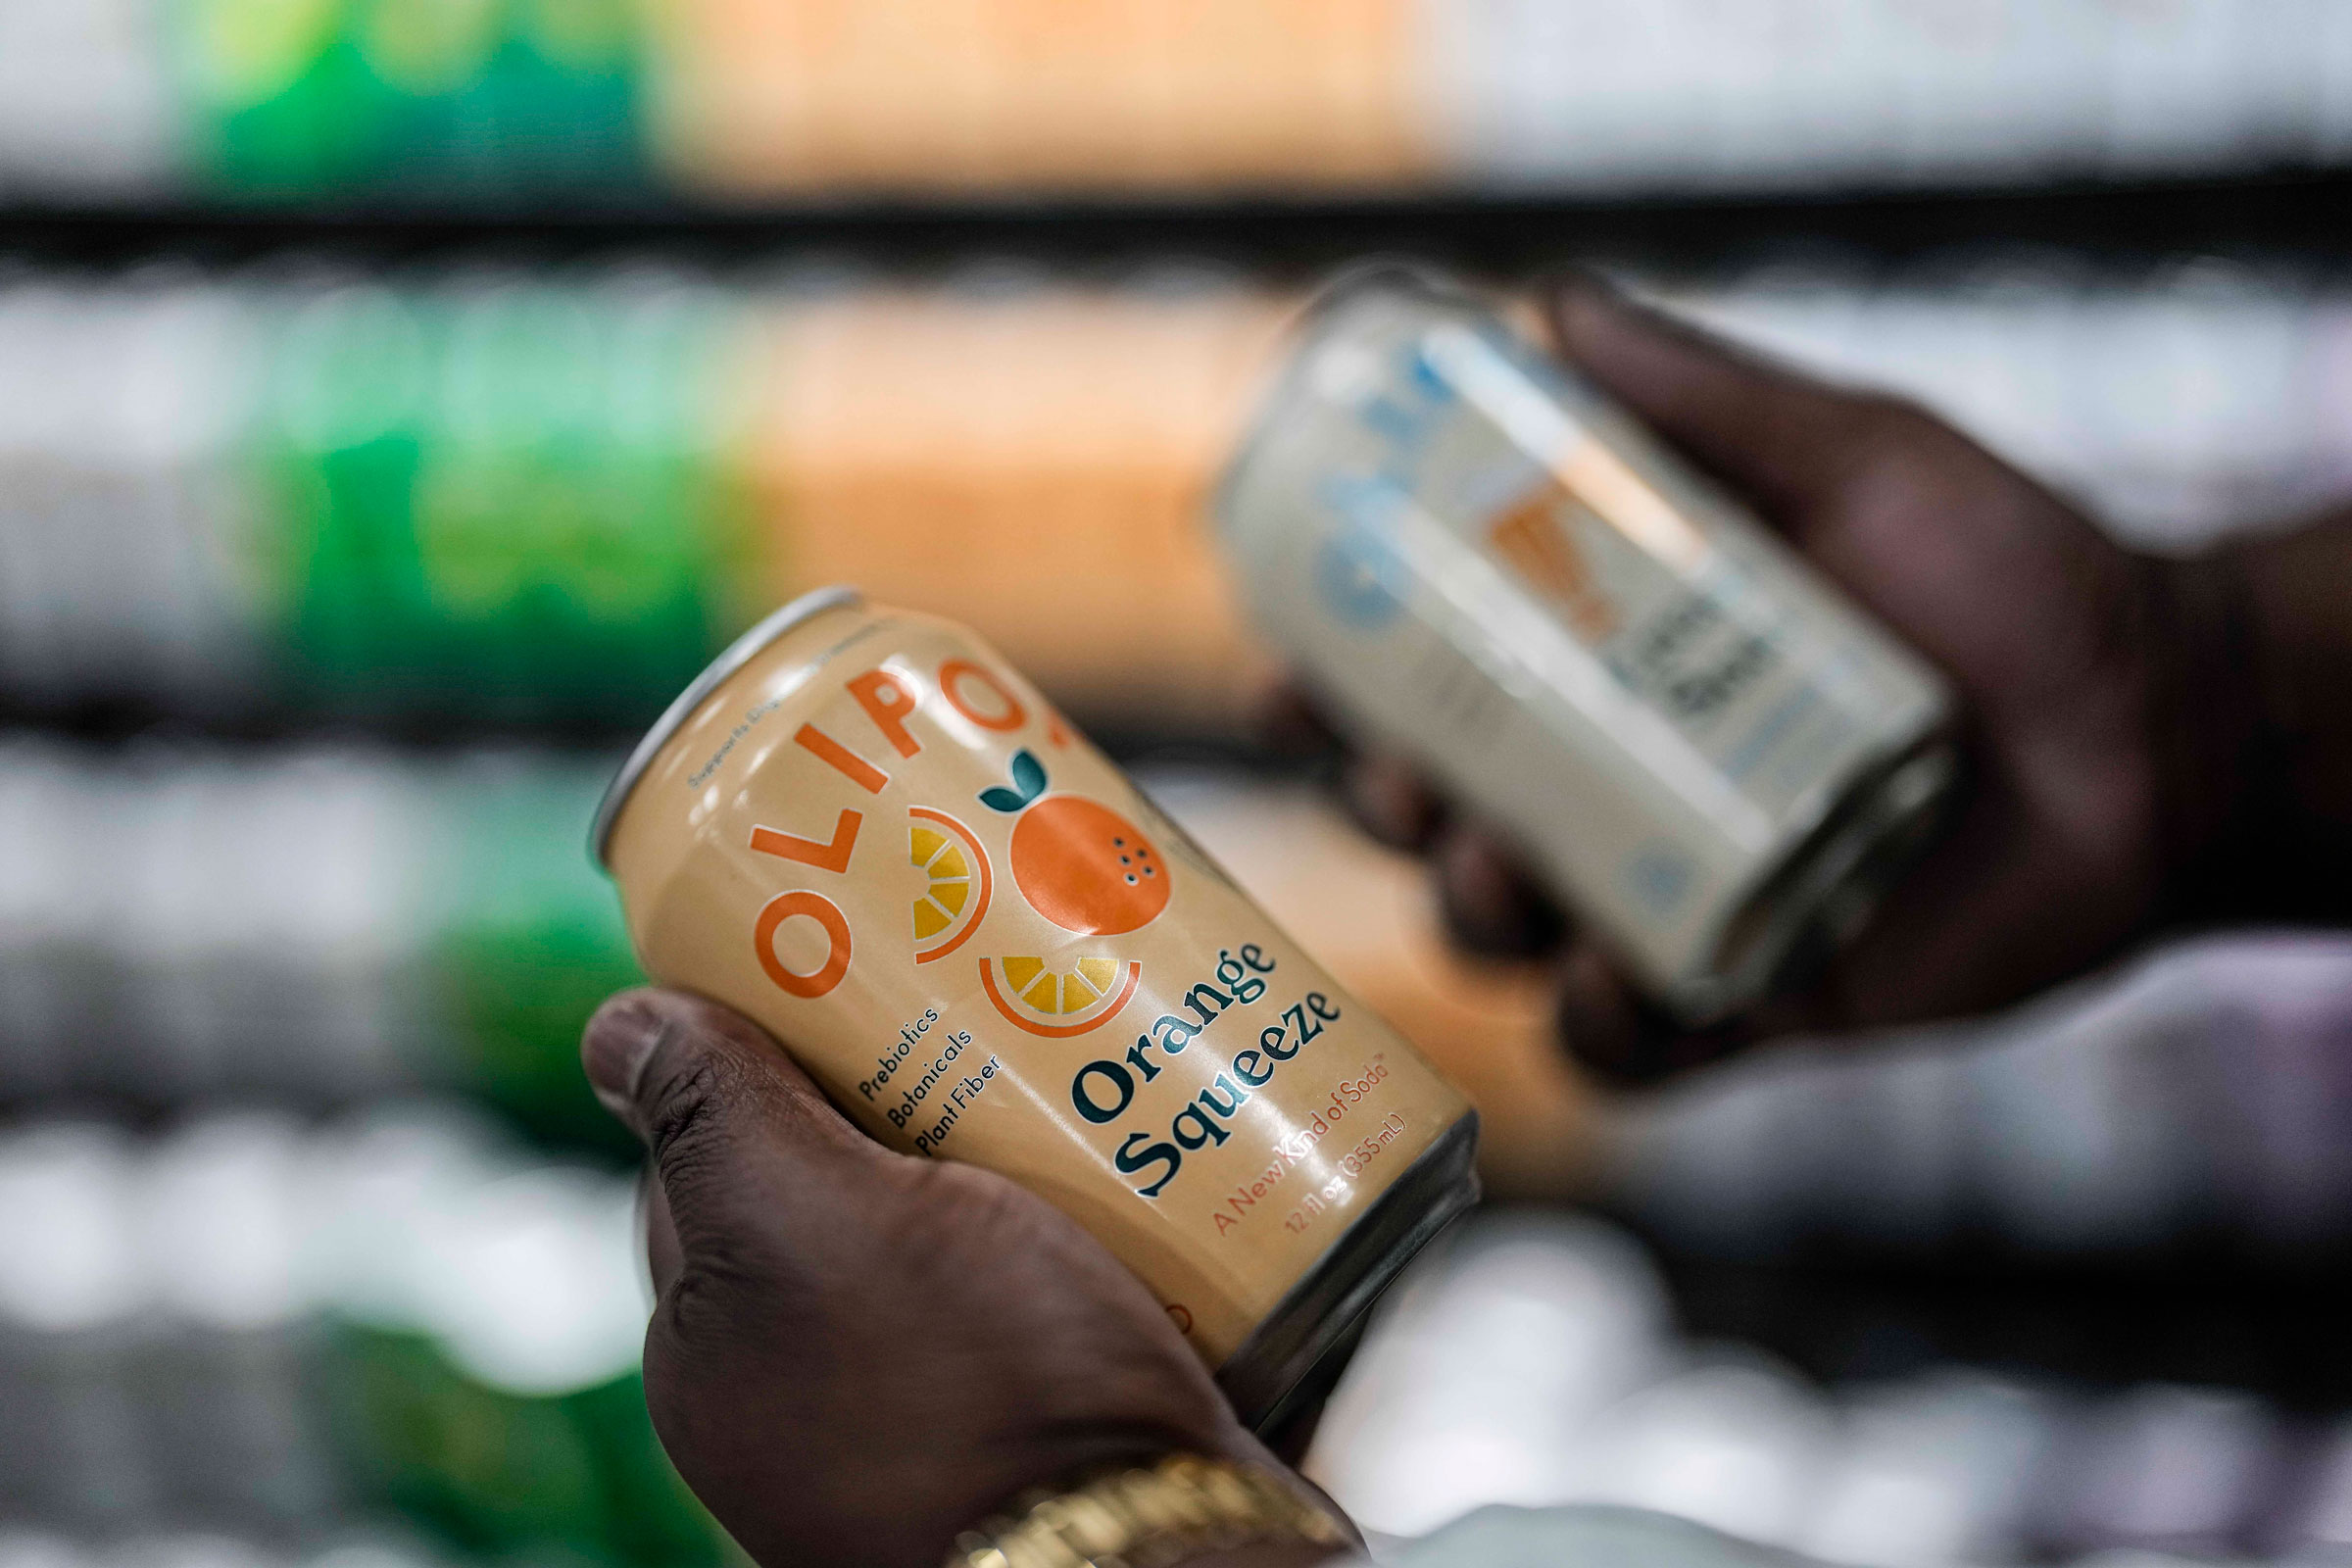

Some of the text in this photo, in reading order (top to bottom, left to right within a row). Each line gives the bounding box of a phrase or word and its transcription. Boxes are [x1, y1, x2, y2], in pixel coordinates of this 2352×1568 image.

[858, 1007, 939, 1102] Prebiotics
[886, 1030, 972, 1128] Botanicals
[1071, 943, 1276, 1124] Orange
[913, 1054, 1001, 1156] Plant Fiber
[1114, 992, 1341, 1198] Squeeze
[1213, 1211, 1239, 1237] A
[1227, 1160, 1285, 1216] New
[1273, 1110, 1331, 1167] Kind
[1327, 1092, 1349, 1121] of
[1284, 1112, 1407, 1234] 12 fl oz (355 mL)
